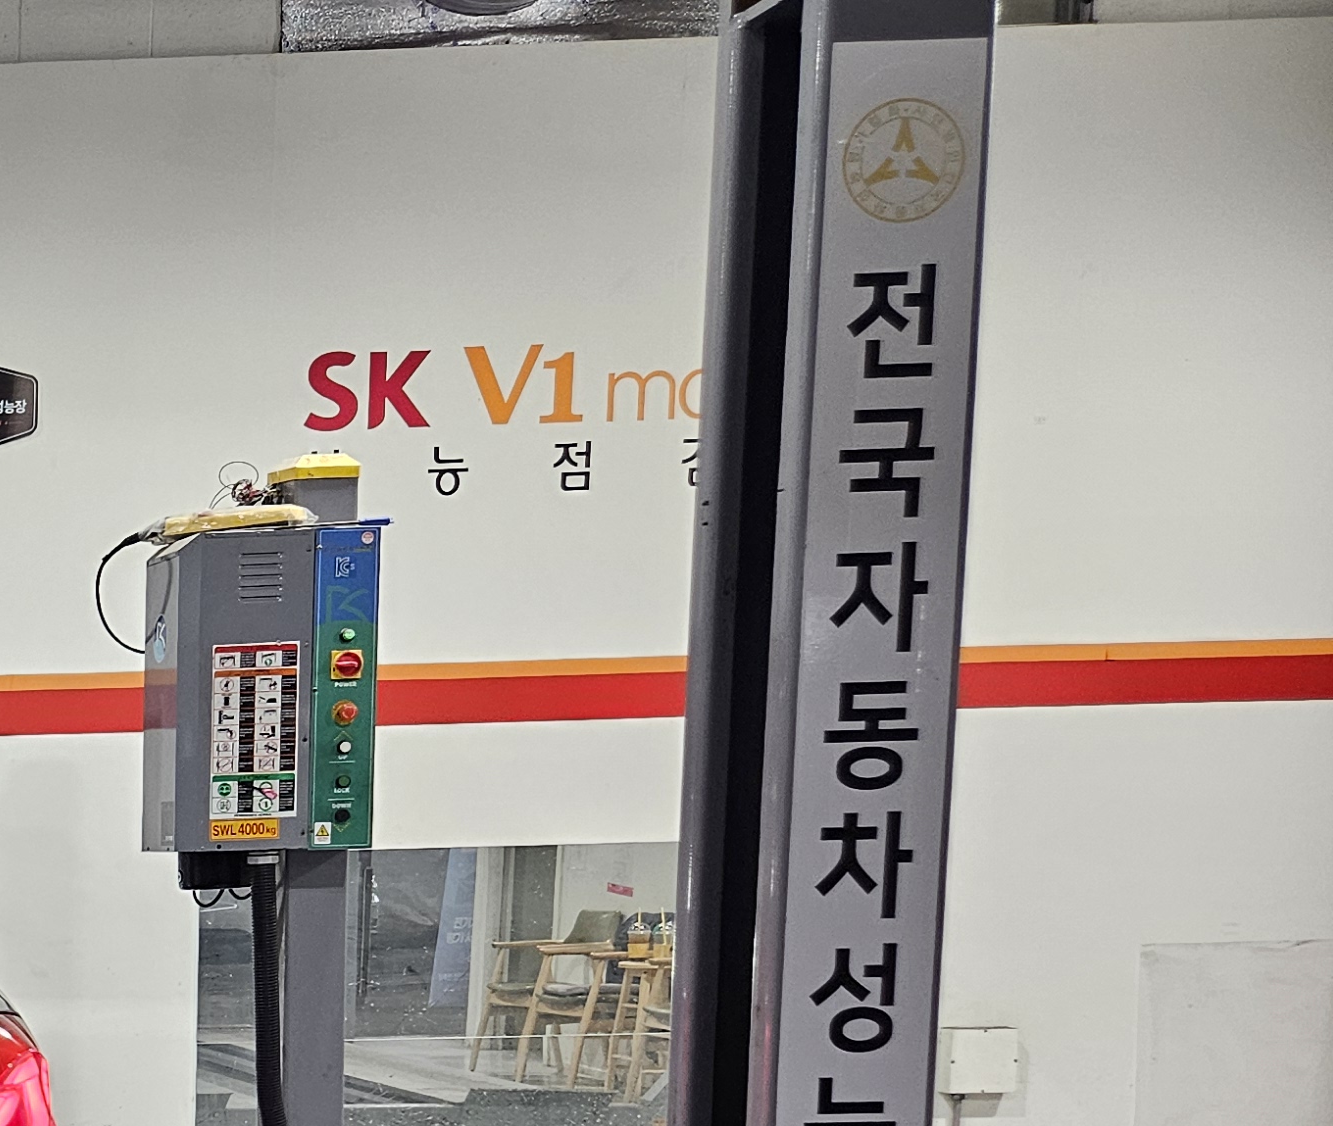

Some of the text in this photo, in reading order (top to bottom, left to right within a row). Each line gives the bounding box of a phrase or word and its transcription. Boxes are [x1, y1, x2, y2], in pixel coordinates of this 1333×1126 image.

[303, 349, 431, 431] SK
[463, 343, 584, 425] V1
[213, 825, 236, 836] SWL
